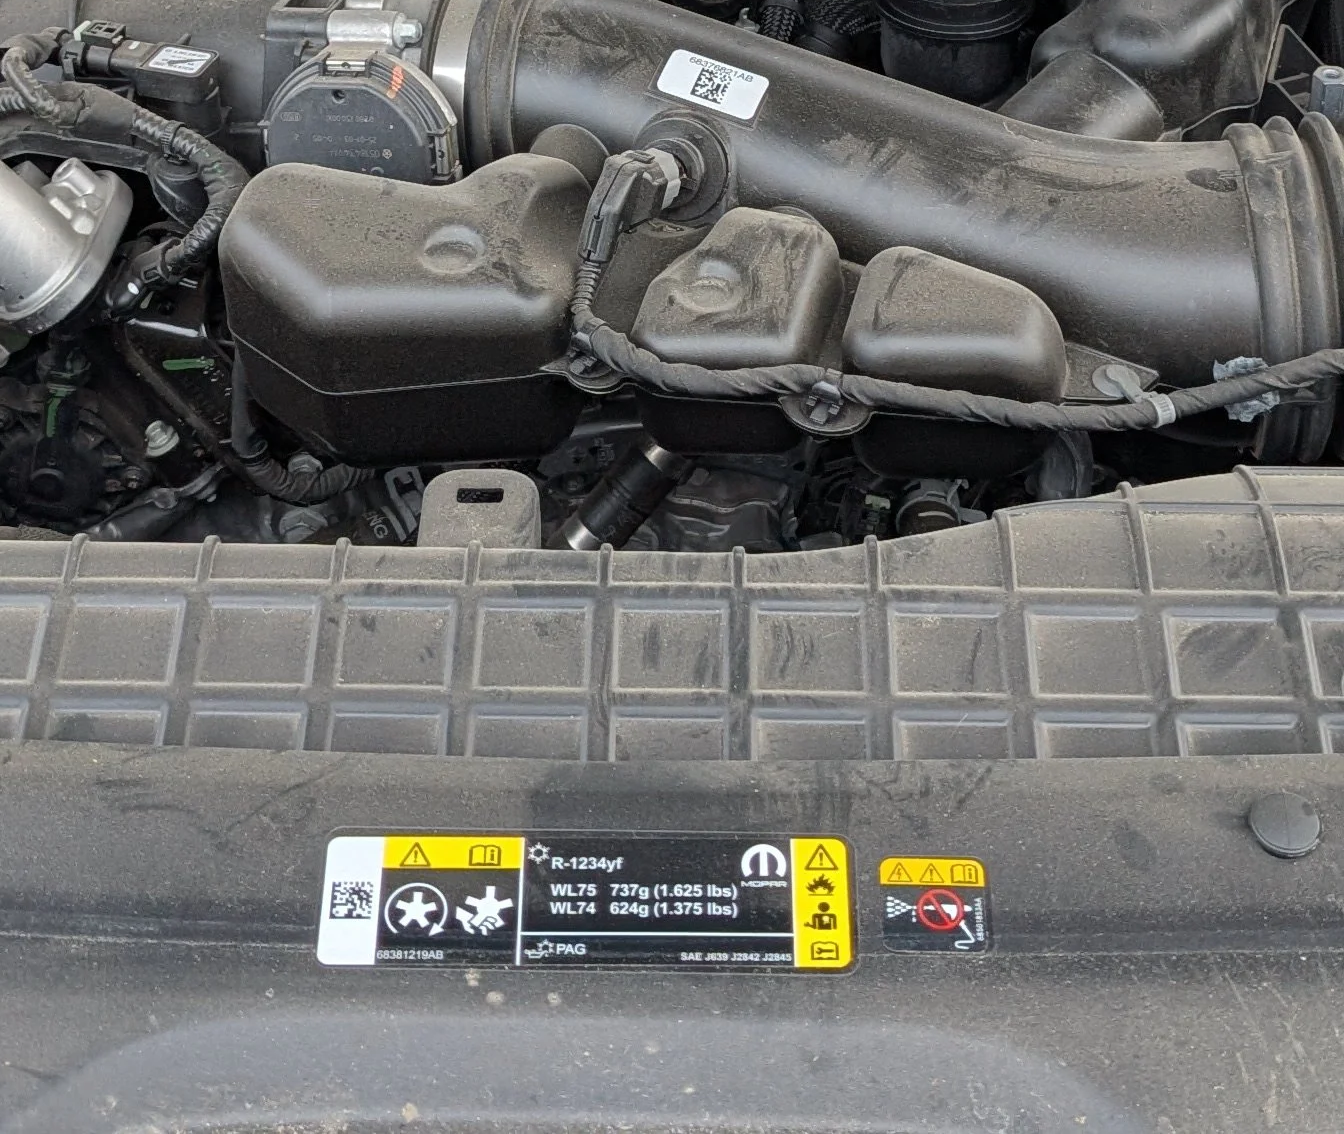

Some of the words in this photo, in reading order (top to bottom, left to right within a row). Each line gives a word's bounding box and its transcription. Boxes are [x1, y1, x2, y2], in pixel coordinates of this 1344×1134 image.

[689, 56, 754, 82] 68376821AB
[551, 856, 624, 873] R-1234yf
[741, 880, 787, 888] MOPAR
[550, 883, 598, 897] WL75
[610, 883, 650, 900] 737g
[654, 882, 704, 900] (1.625
[707, 882, 738, 901] lbs)
[550, 902, 597, 915] WL74
[609, 901, 649, 918] 624g
[653, 901, 704, 918] (1.375
[707, 901, 738, 919] lbs)
[377, 950, 443, 960] 68381219AB
[556, 943, 587, 955] PAG
[680, 951, 703, 962] SAE
[704, 952, 729, 962] J639
[730, 952, 761, 962] J2842
[762, 952, 792, 962] J2845
